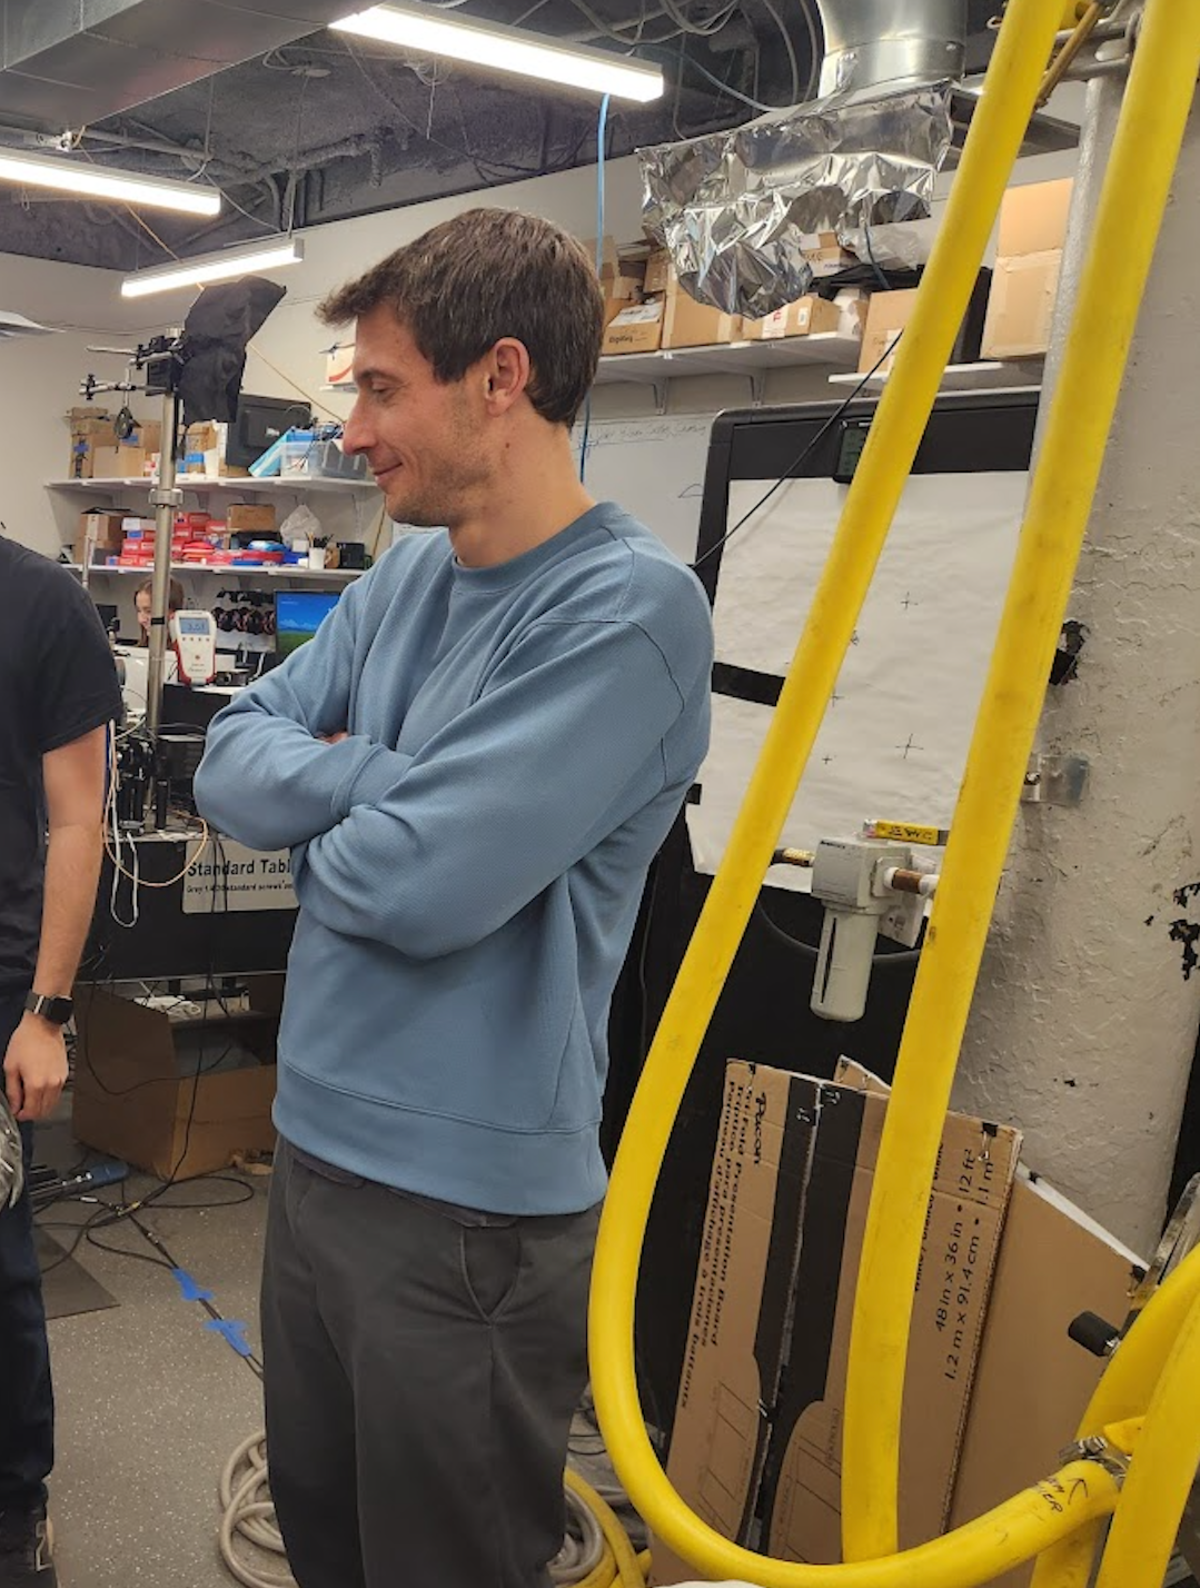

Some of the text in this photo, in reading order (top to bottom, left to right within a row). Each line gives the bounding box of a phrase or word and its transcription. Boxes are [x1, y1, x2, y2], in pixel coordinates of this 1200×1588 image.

[187, 860, 255, 877] Standard
[718, 1081, 735, 1159] Panneau
[754, 1092, 767, 1164] Pacon
[721, 1158, 732, 1200] para
[959, 1174, 973, 1193] 12
[976, 1187, 990, 1206] 1.1
[720, 1162, 742, 1281] Presentation
[950, 1222, 963, 1238] in
[945, 1242, 959, 1265] 36
[968, 1235, 980, 1264] cm
[702, 1205, 725, 1347] presentaciones
[945, 1271, 955, 1283] x
[957, 1267, 974, 1305] 91.4
[694, 1285, 706, 1327] trois
[939, 1288, 951, 1306] in
[711, 1288, 725, 1347] Board
[935, 1308, 948, 1332] 48
[957, 1312, 967, 1325] x
[953, 1329, 963, 1349] m
[681, 1333, 700, 1409] battants
[945, 1354, 960, 1380] 1.2
